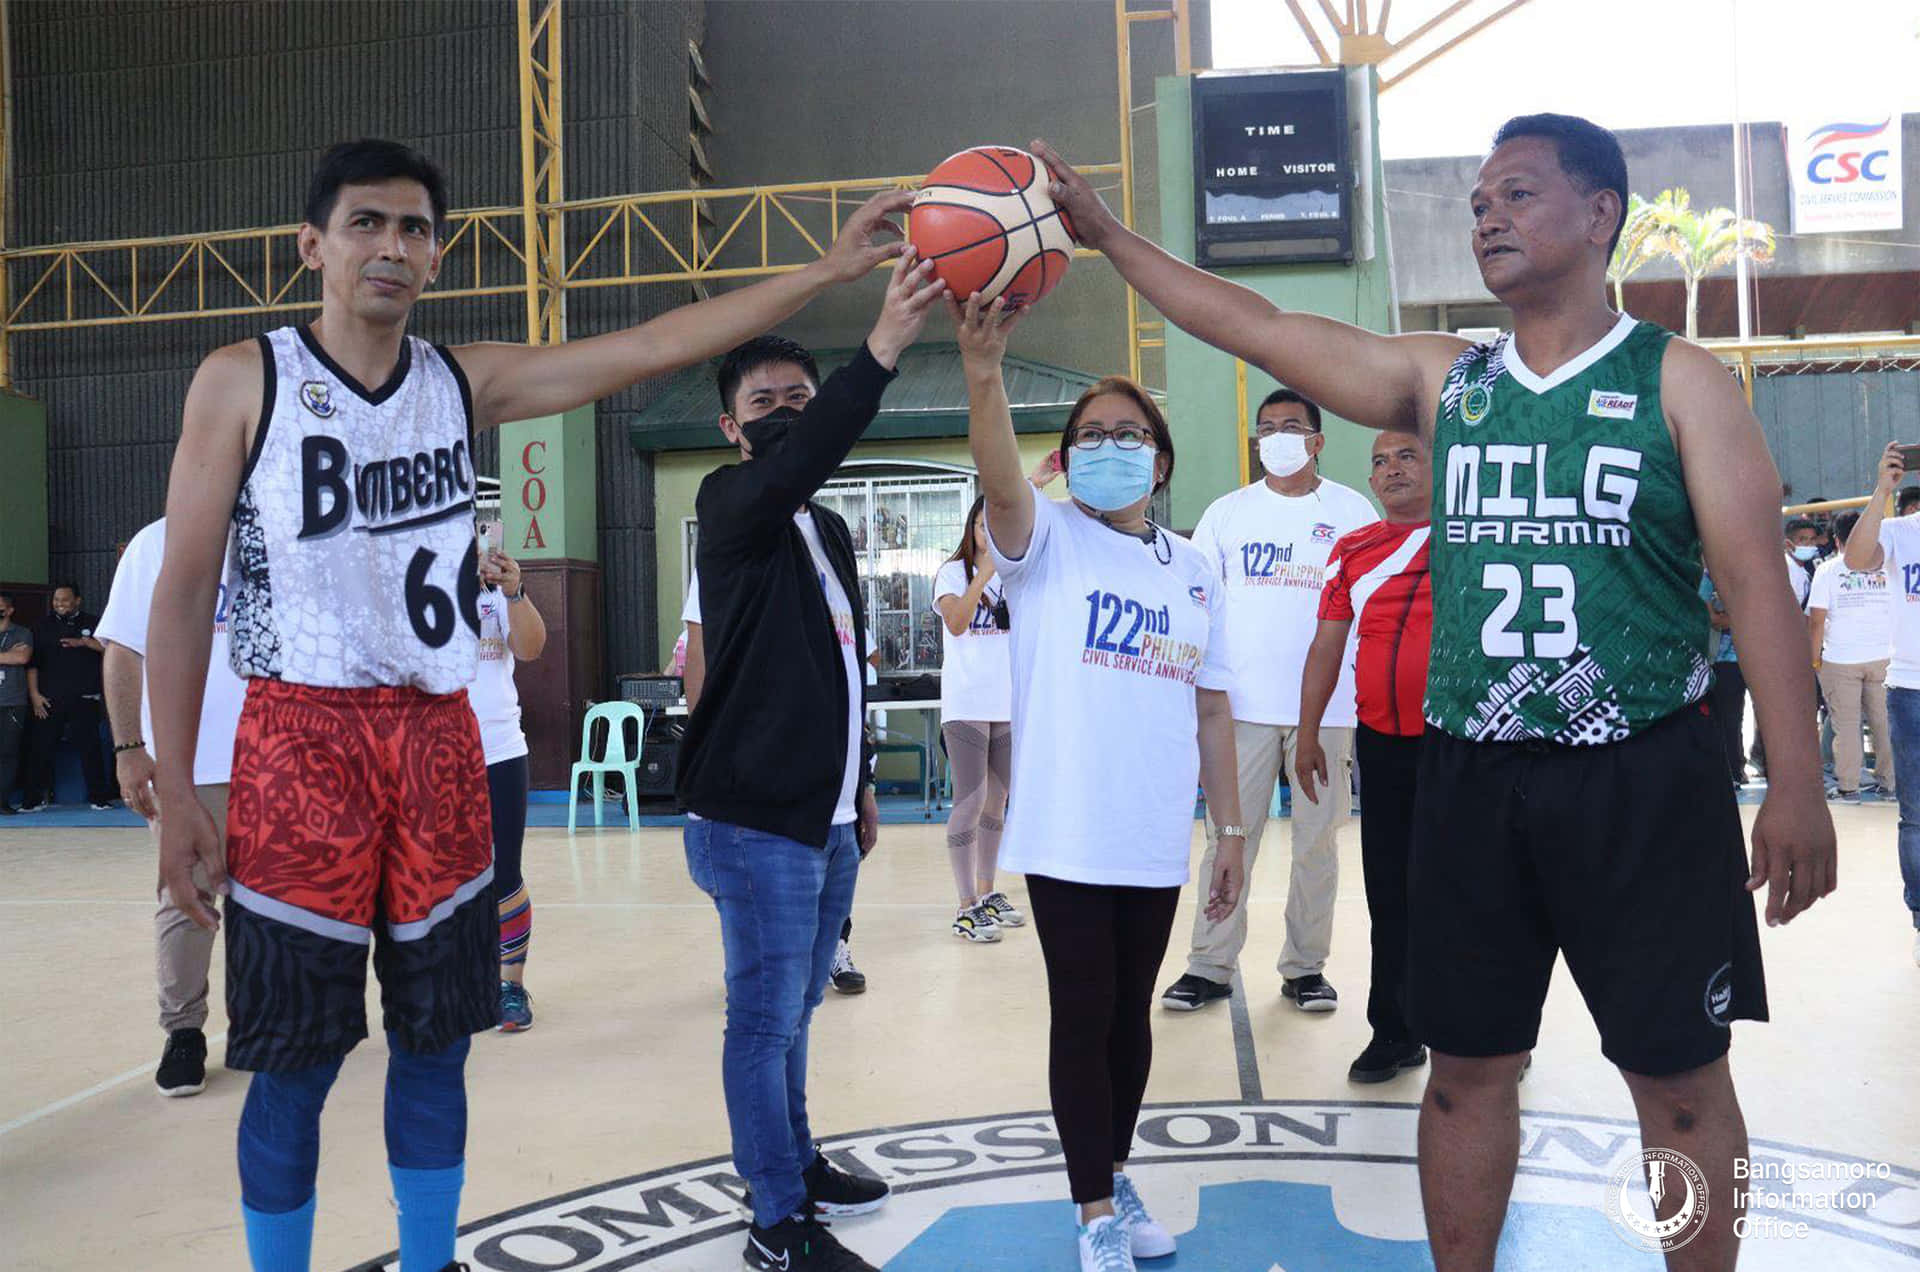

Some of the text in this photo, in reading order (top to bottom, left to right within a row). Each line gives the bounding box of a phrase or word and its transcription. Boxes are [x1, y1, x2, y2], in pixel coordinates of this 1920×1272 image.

[1245, 125, 1295, 136] TIME
[1216, 163, 1336, 177] HOME VISITOR
[1806, 149, 1890, 184] CSC
[522, 440, 547, 549] COA
[1445, 443, 1643, 523] MILG
[1446, 520, 1631, 547] BARMM
[1241, 542, 1293, 577] 122nd
[1086, 589, 1170, 657] 122nd
[1481, 563, 1578, 658] 23
[1083, 649, 1109, 668] CIVIL
[1112, 654, 1154, 676] SERVICE
